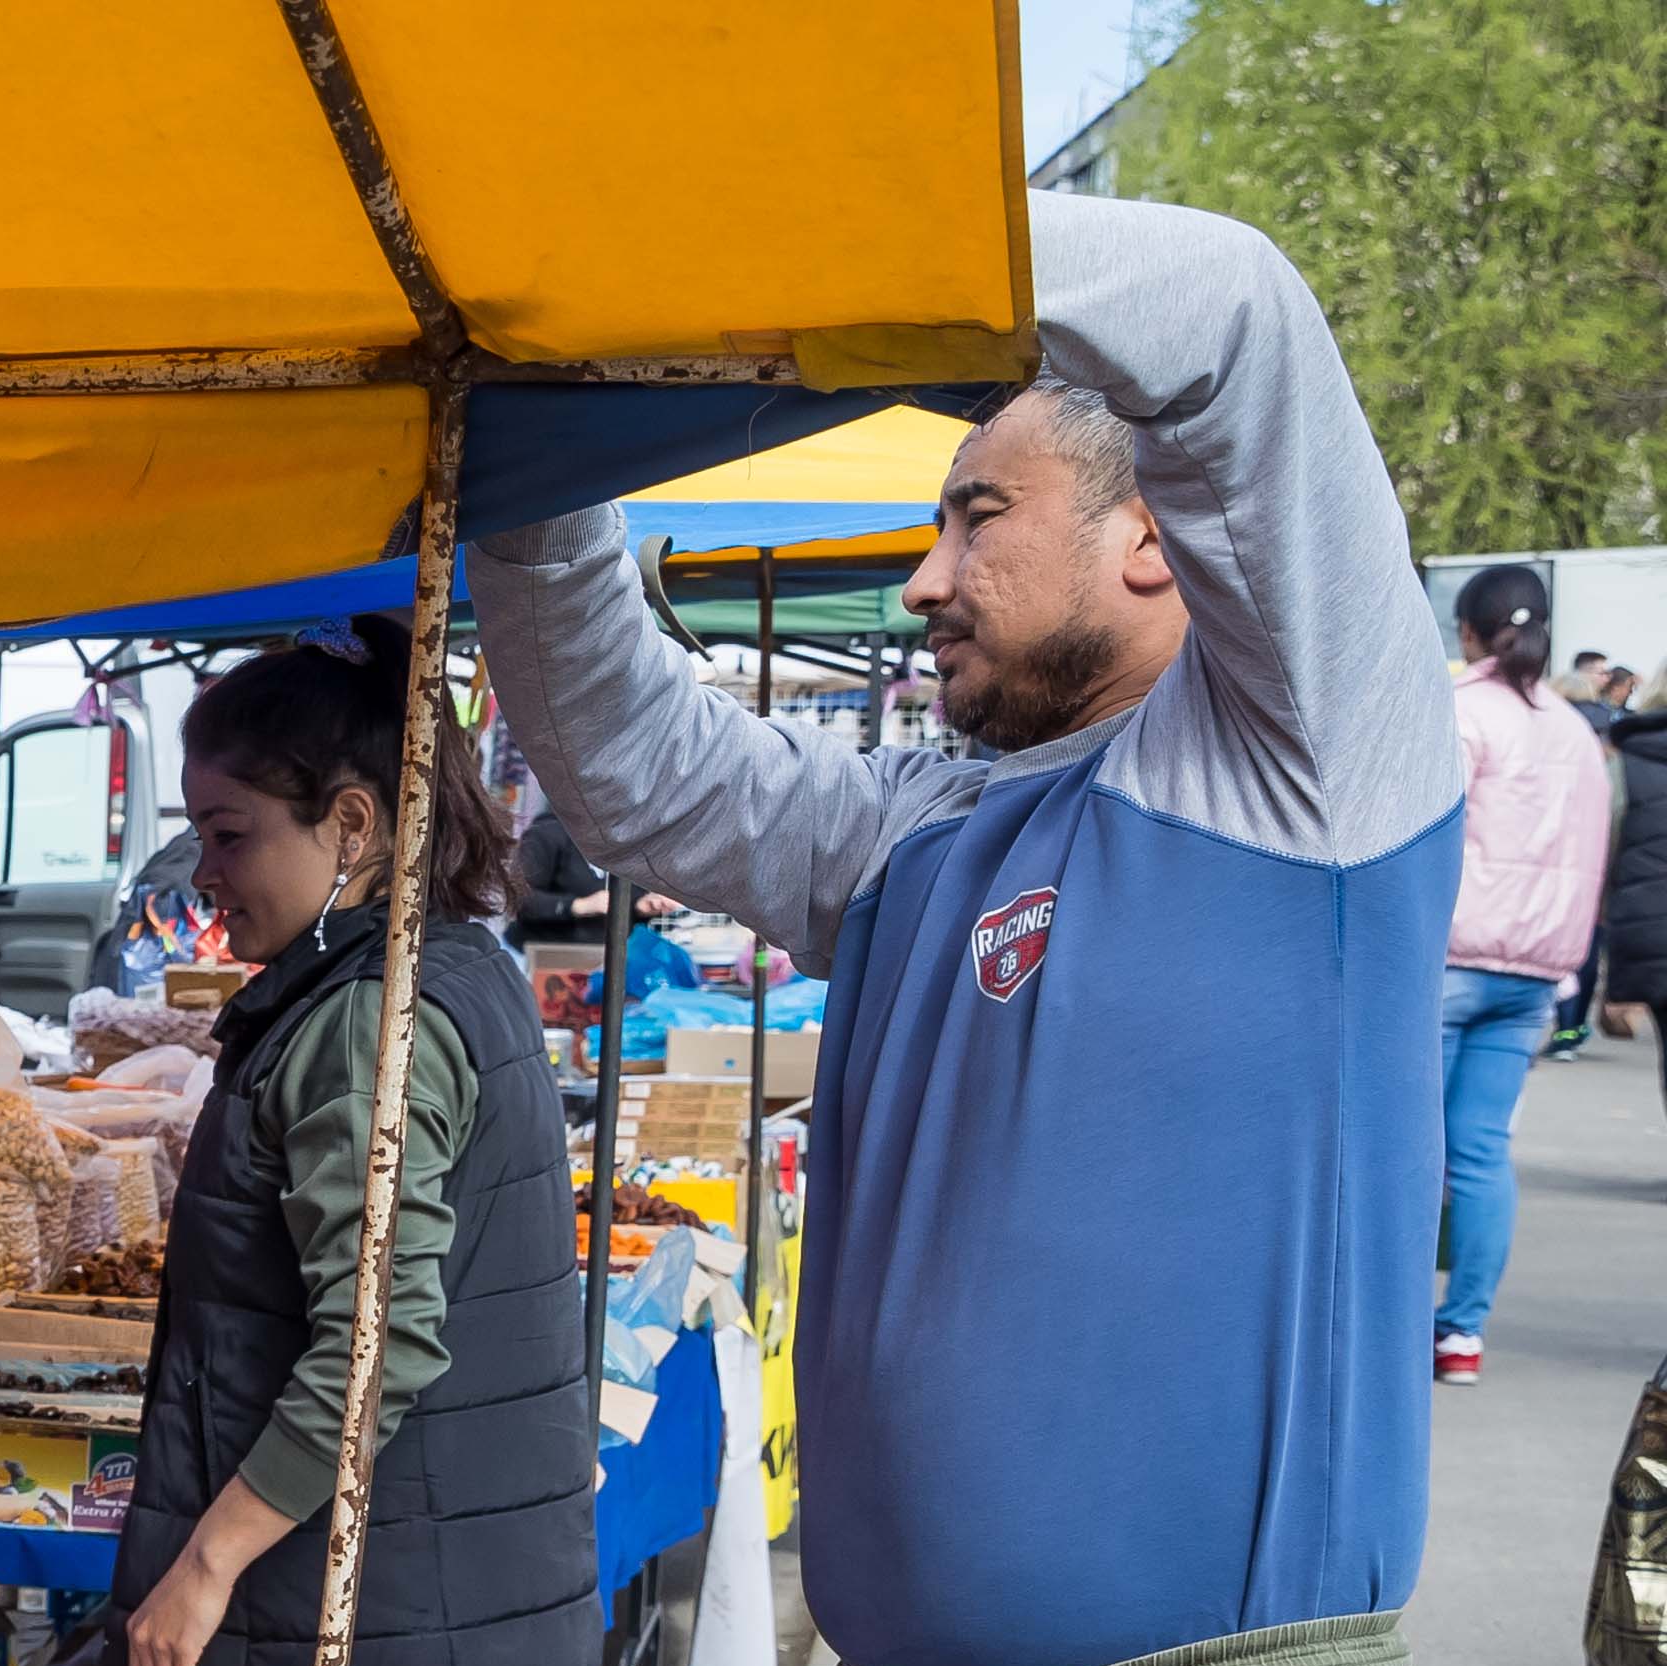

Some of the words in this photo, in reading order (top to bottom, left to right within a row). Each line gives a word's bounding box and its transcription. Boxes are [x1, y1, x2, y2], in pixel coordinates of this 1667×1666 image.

[978, 900, 1054, 958] RACING
[105, 1461, 132, 1478] 777
[73, 1505, 109, 1516] Extra
